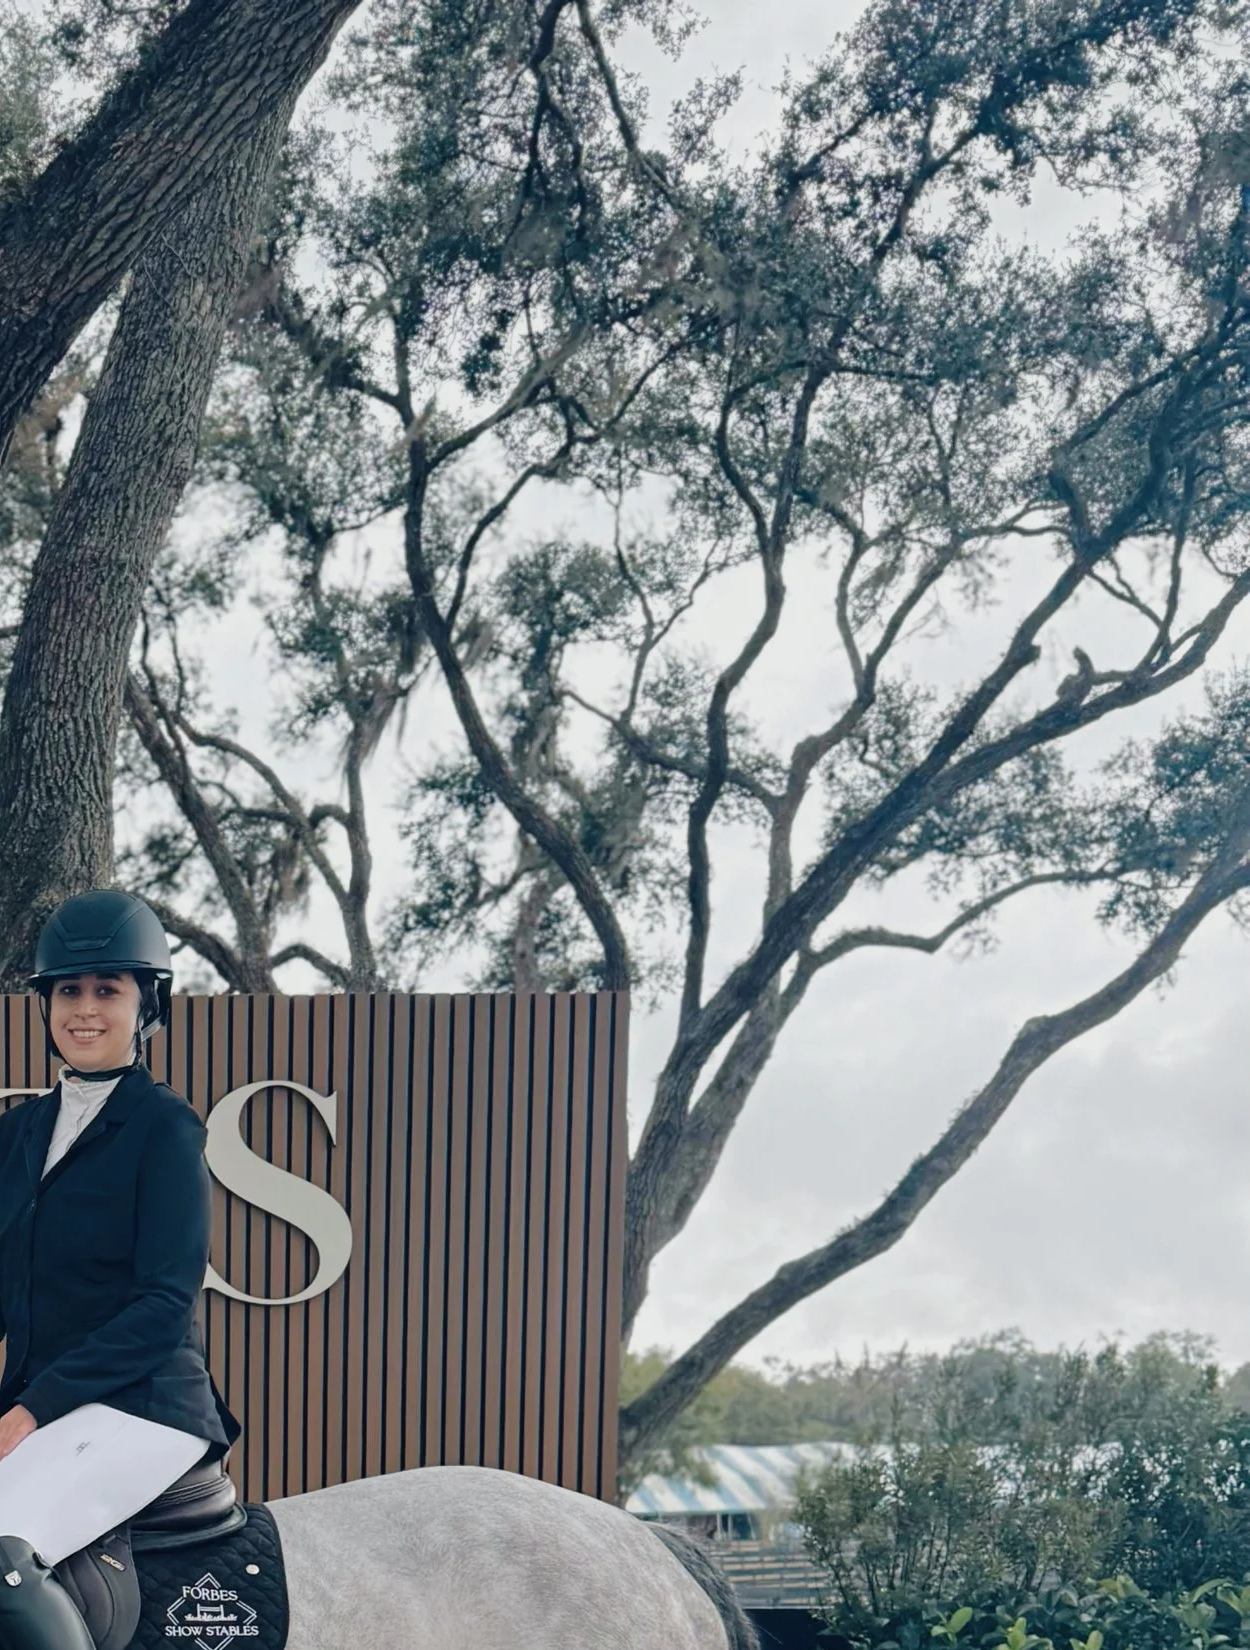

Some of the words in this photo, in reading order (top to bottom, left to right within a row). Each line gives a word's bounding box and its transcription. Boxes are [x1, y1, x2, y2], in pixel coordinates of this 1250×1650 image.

[182, 1586, 238, 1601] FORBES
[165, 1626, 203, 1637] SHOW
[206, 1625, 259, 1637] STABLES
